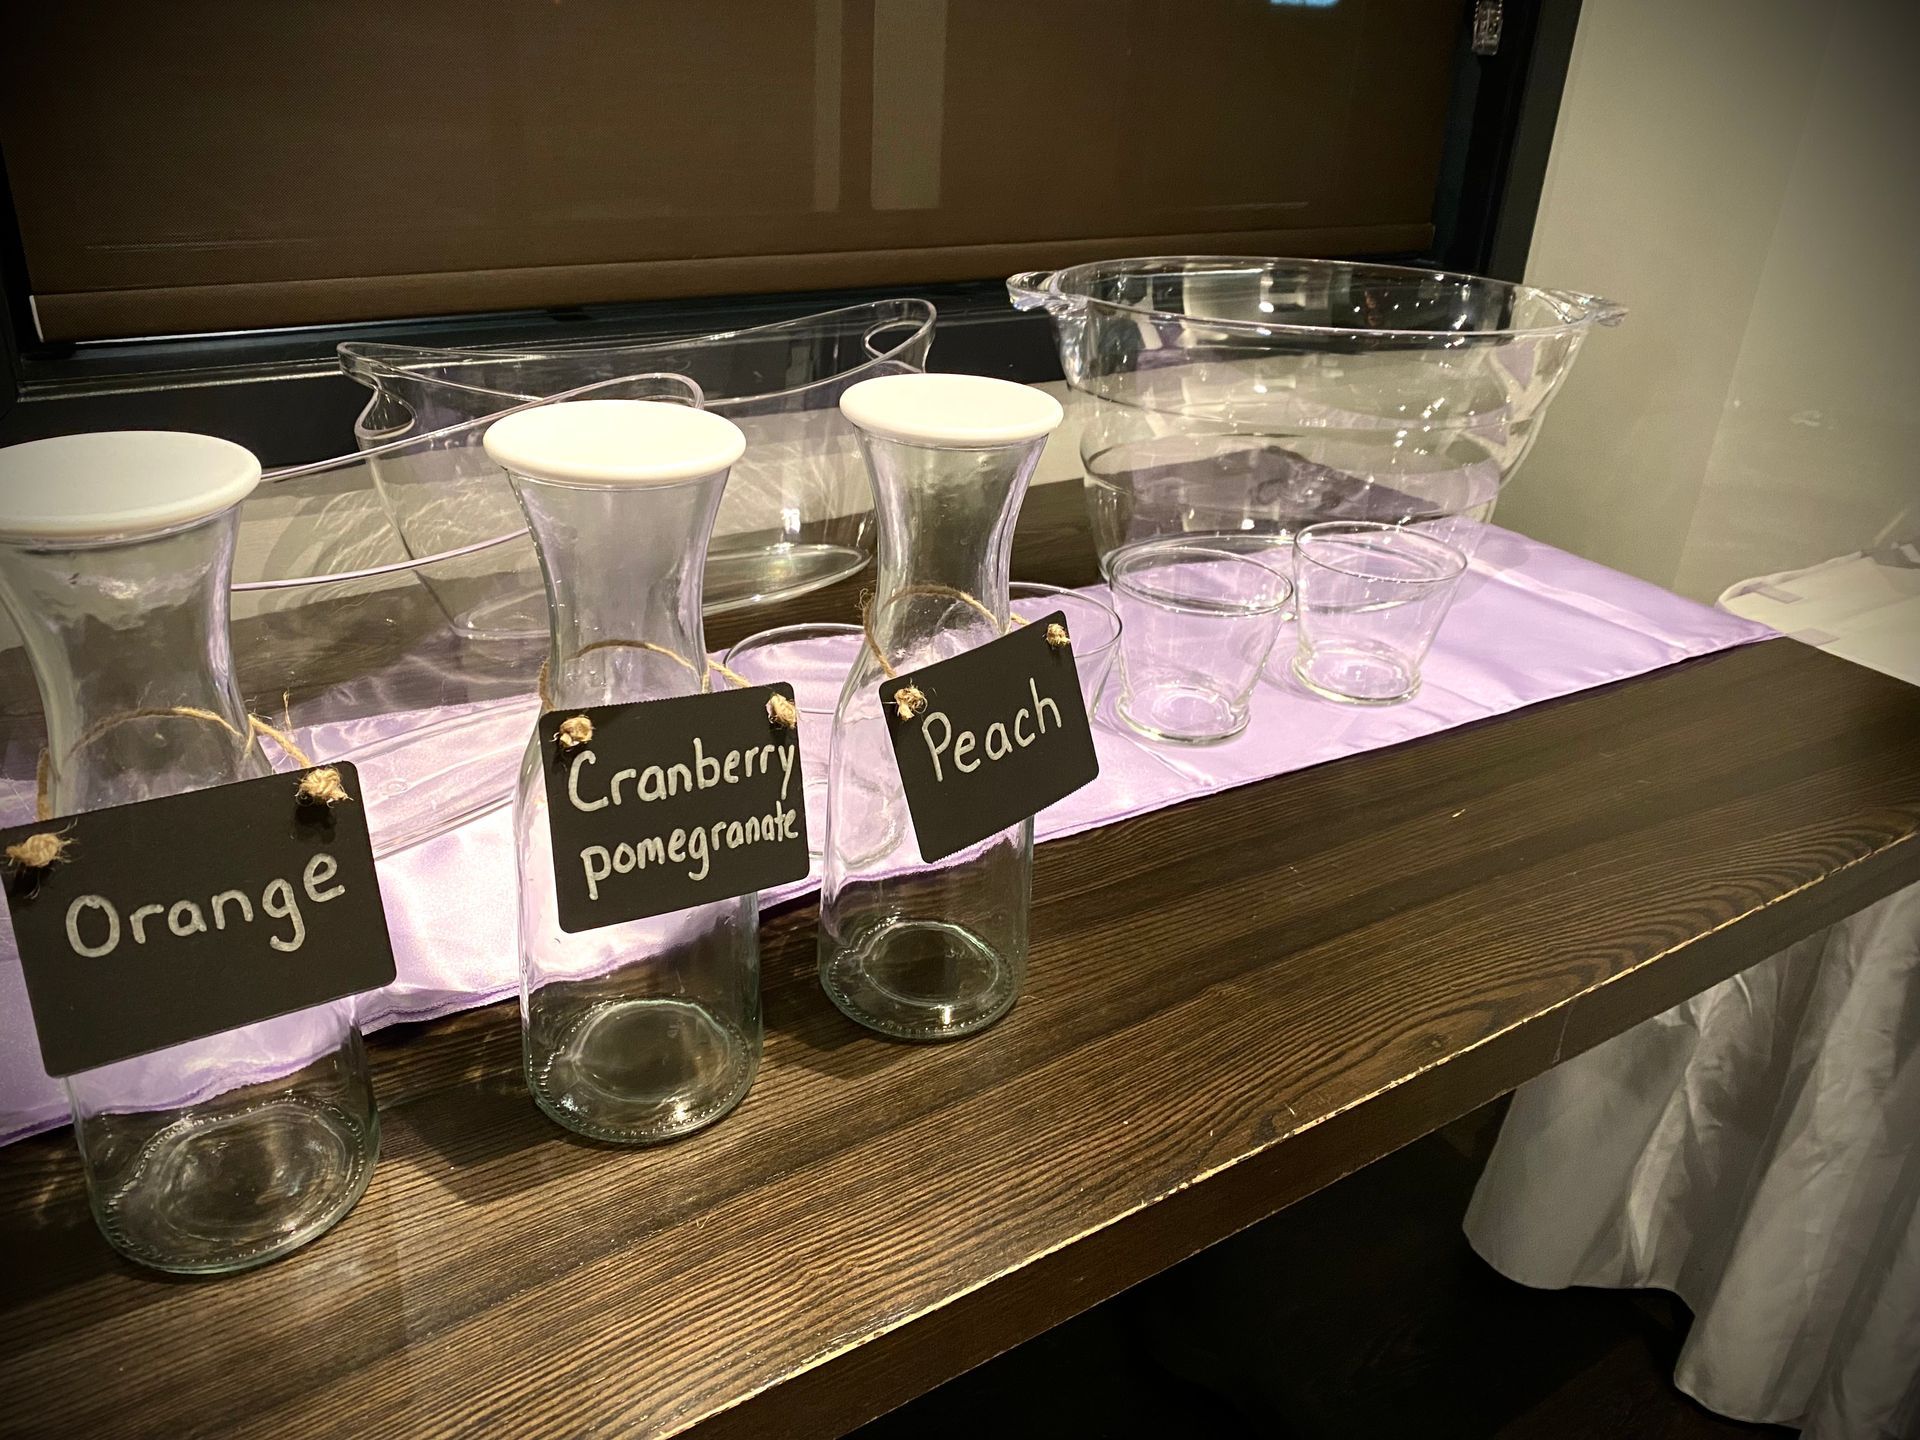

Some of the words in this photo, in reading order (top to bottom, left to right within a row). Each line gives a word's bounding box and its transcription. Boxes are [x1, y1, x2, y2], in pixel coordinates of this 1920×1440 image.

[568, 737, 795, 812] Cranberry
[921, 677, 1062, 783] Peach
[580, 800, 799, 901] pomegranate
[65, 852, 346, 958] Orange
